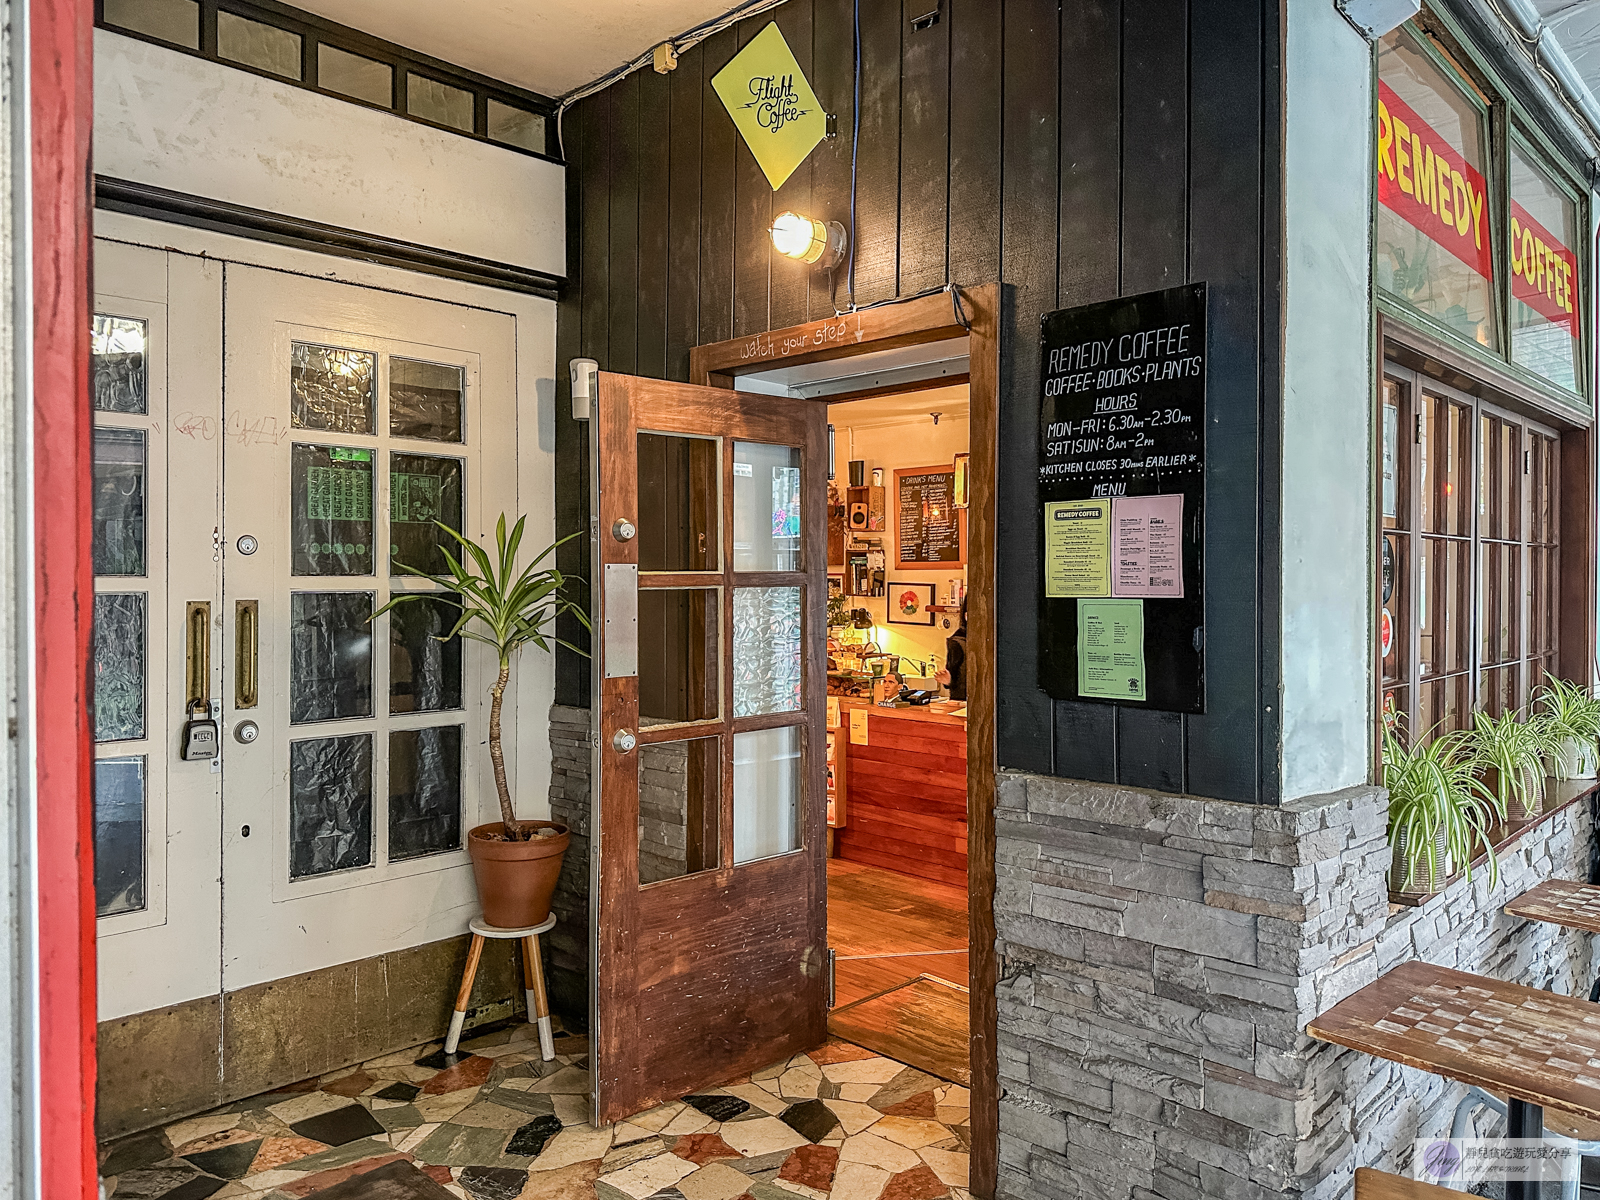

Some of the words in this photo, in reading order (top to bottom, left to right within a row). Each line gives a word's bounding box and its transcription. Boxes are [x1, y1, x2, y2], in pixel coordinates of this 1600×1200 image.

[749, 74, 799, 104] Flight
[757, 98, 800, 133] Coffee
[1378, 98, 1483, 251] REMEDY
[1511, 216, 1573, 314] COFFEE
[740, 334, 775, 359] watch
[781, 335, 808, 356] your
[812, 321, 847, 346] step
[1048, 338, 1114, 374] REMEDY
[1119, 324, 1190, 362] COFFEE
[1095, 393, 1138, 412] HOURS
[1085, 458, 1117, 472] CLOSES
[927, 474, 946, 483] MENU
[1092, 482, 1127, 497] MENU
[311, 496, 319, 517] GREAT
[356, 499, 364, 519] GREAT
